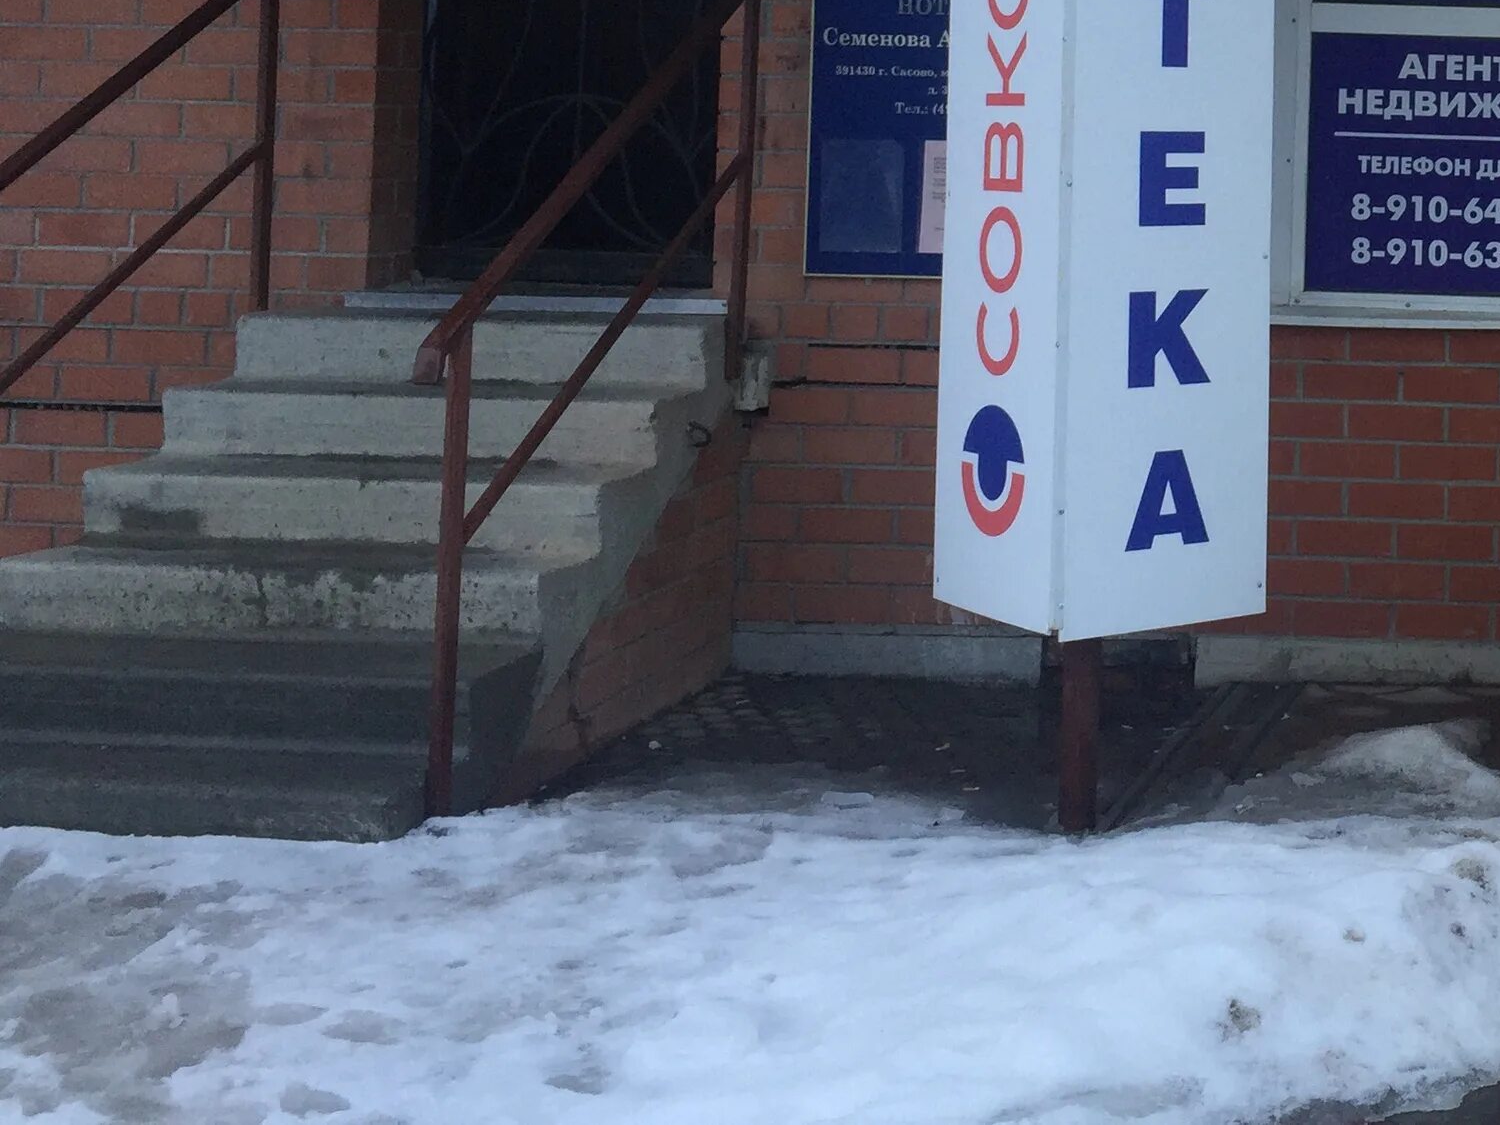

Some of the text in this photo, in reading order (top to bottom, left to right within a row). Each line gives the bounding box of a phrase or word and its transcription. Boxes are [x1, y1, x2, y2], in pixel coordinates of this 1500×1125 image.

[823, 26, 931, 48] Семенова
[932, 103, 948, 115] (4
[1358, 154, 1471, 177] ТЕЛЕФОН
